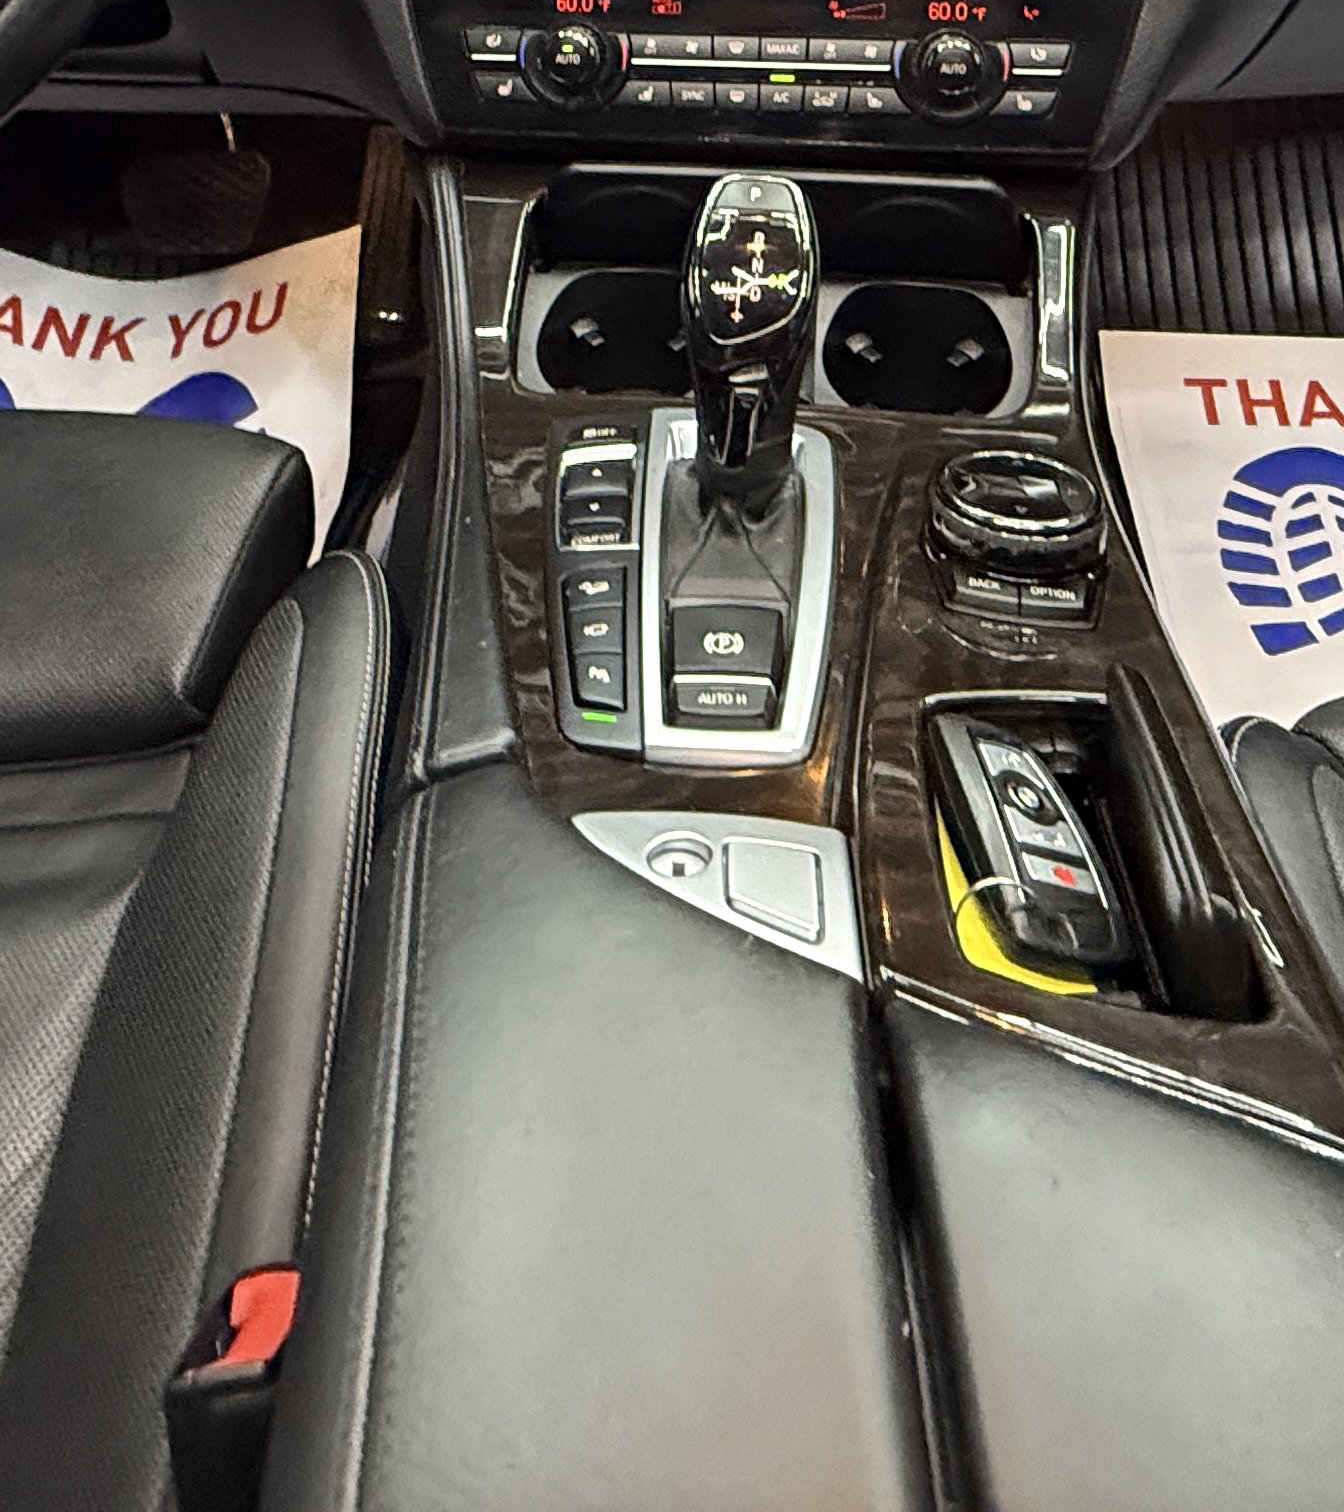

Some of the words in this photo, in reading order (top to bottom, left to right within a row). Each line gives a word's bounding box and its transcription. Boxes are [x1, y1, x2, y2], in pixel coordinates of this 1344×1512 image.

[928, 2, 968, 21] 60.0
[555, 54, 581, 65] AUTO
[939, 63, 967, 75] AUTO
[681, 90, 705, 101] SYNC
[167, 281, 288, 359] YOU
[968, 576, 1001, 590] BACK
[1030, 585, 1076, 601] OPTION
[698, 694, 733, 706] AUTO
[736, 693, 748, 706] H
